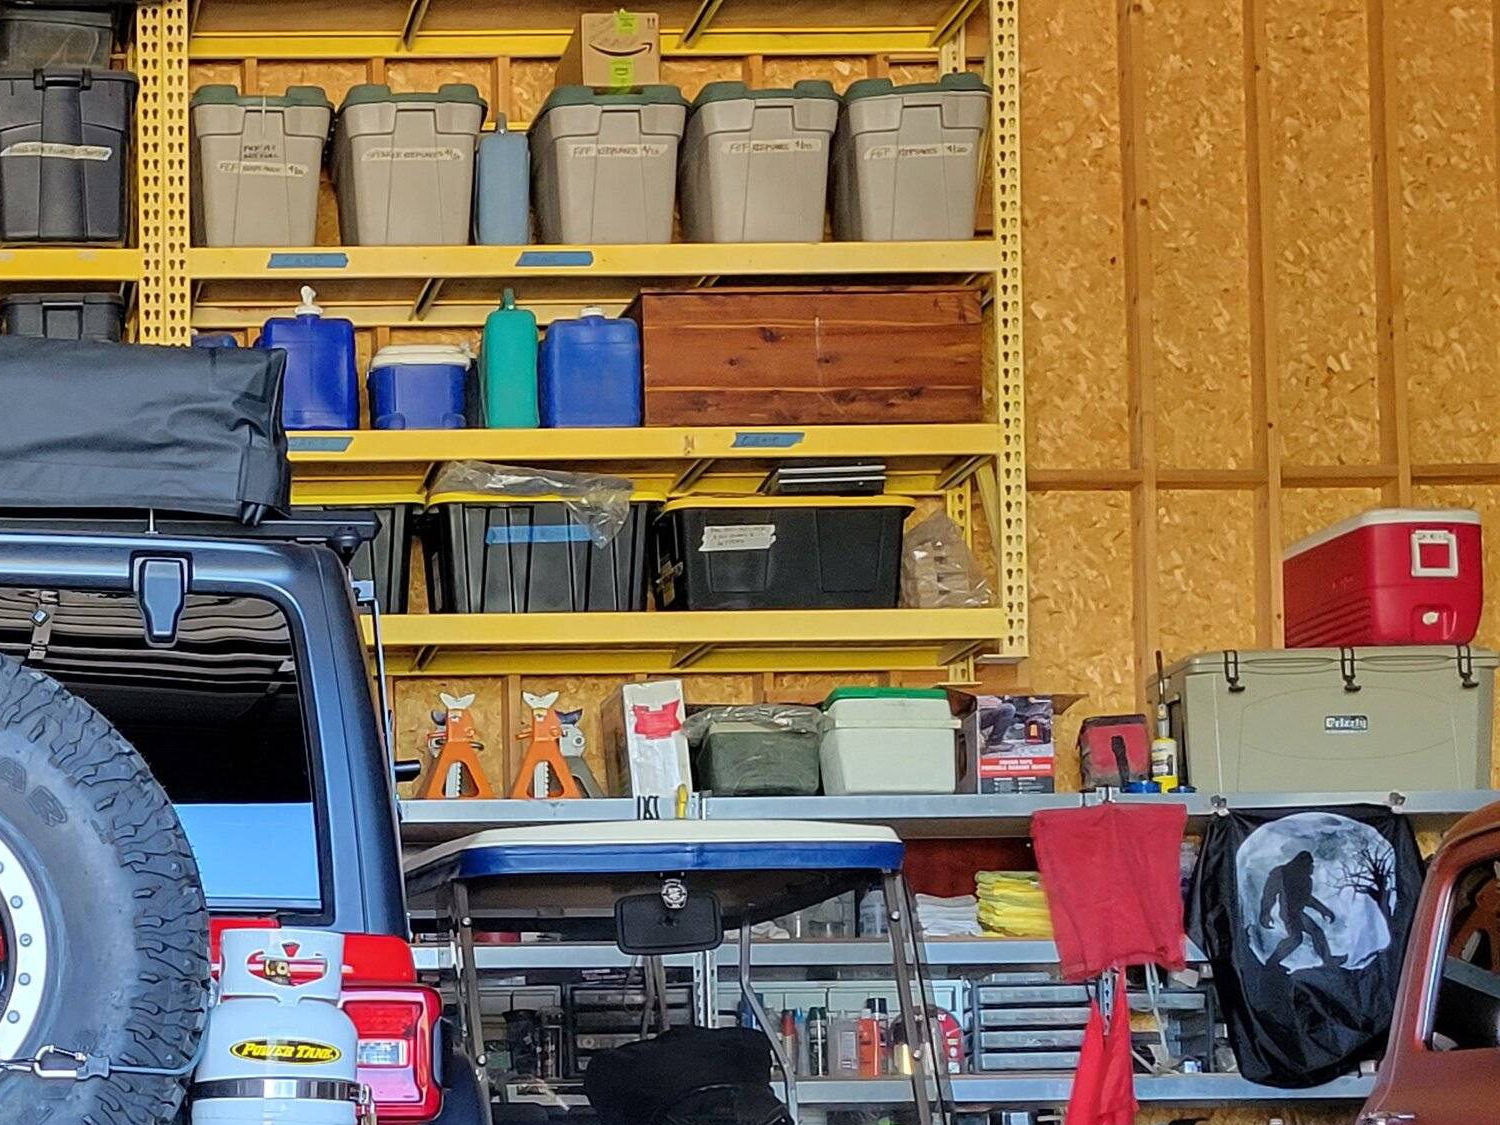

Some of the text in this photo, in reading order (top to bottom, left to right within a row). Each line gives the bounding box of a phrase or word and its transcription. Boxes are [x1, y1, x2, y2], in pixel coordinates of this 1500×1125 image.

[1326, 717, 1367, 728] Grizzly
[242, 1042, 334, 1059] POWER TANK
